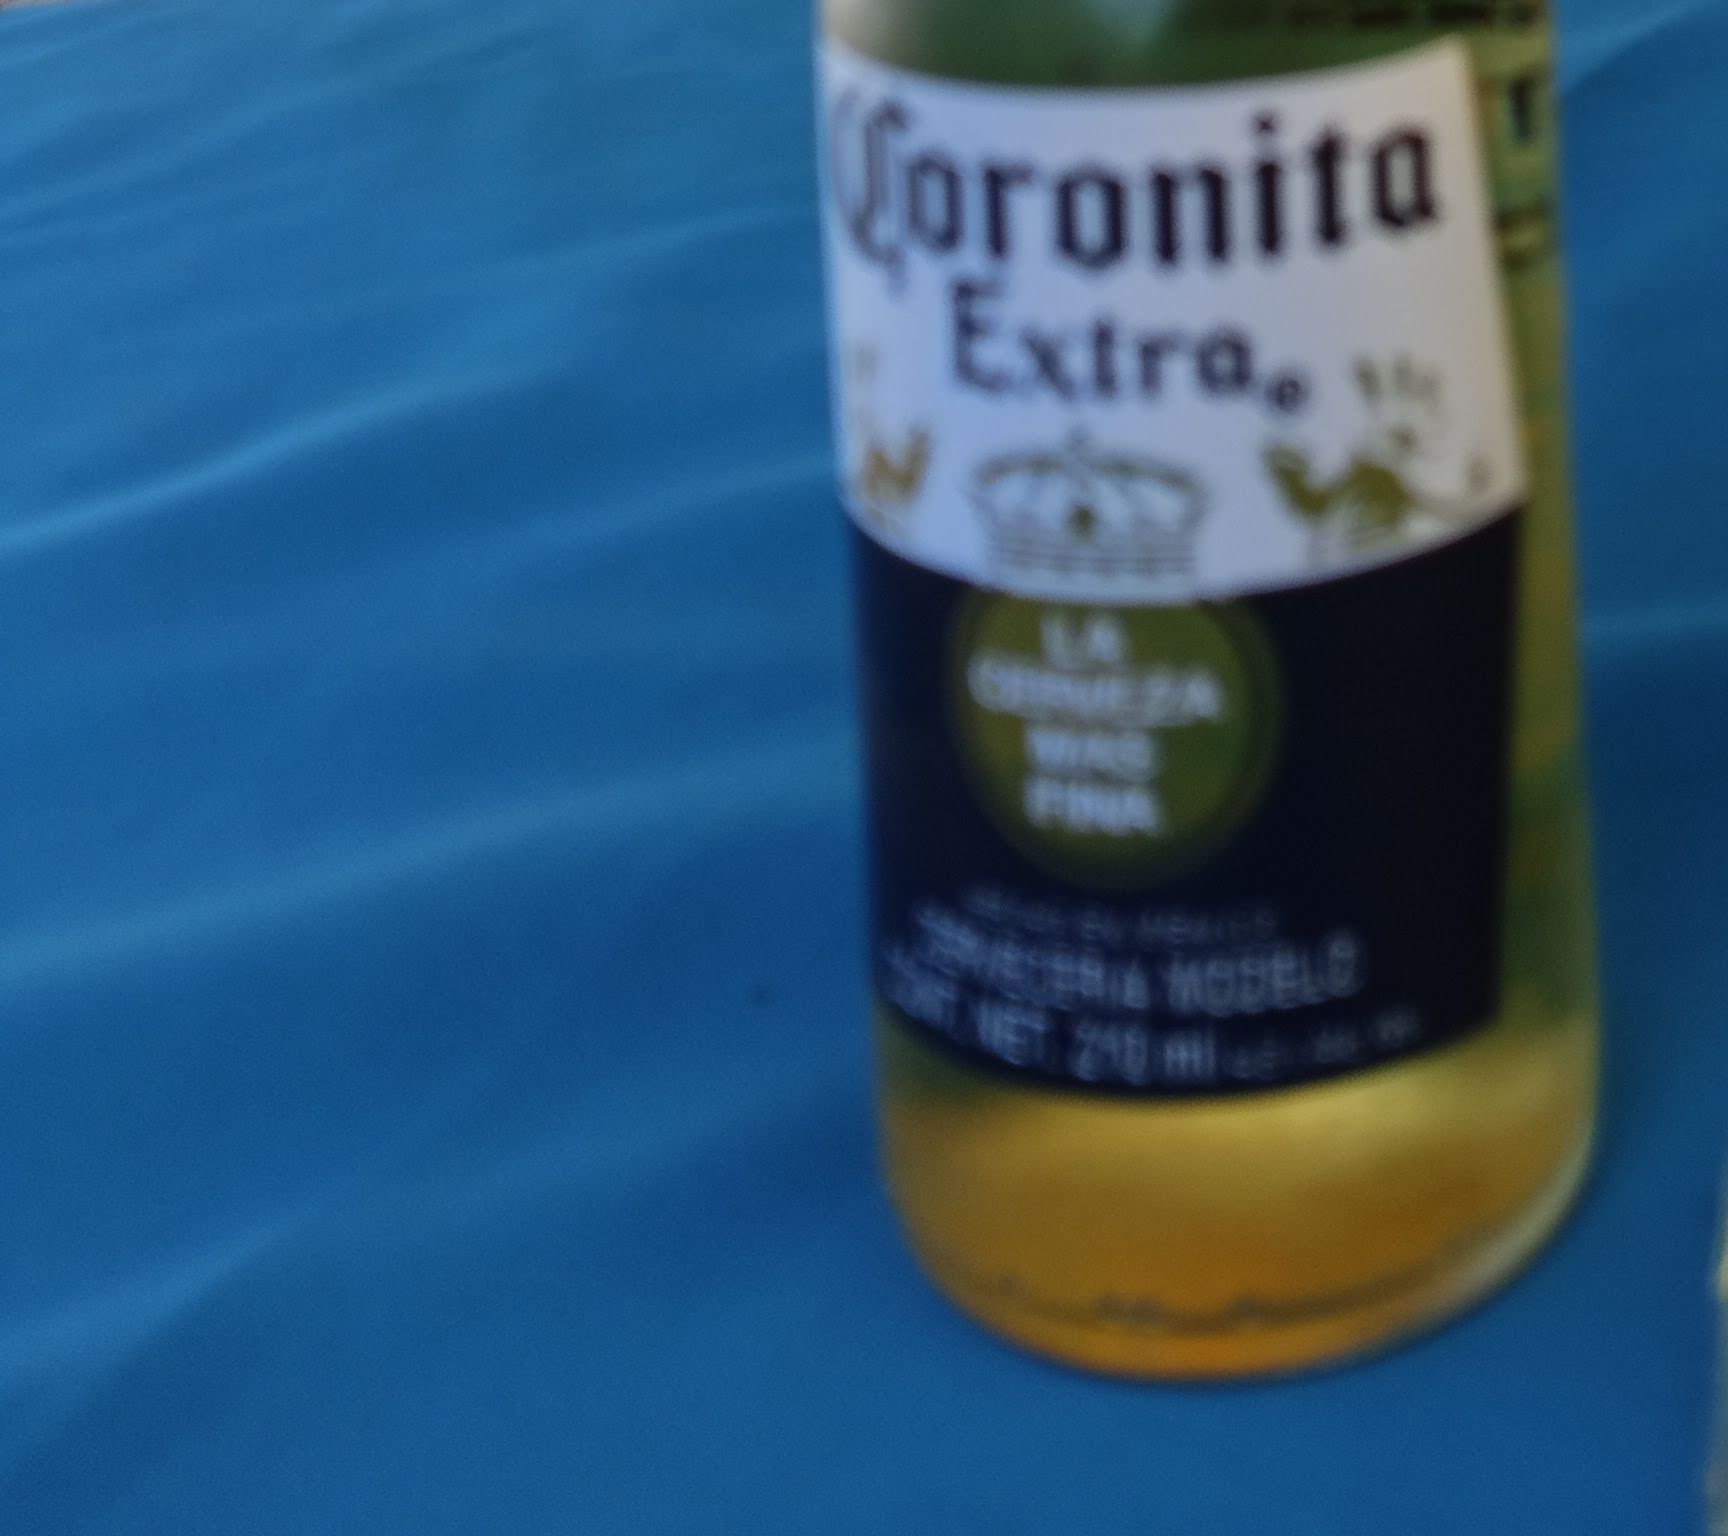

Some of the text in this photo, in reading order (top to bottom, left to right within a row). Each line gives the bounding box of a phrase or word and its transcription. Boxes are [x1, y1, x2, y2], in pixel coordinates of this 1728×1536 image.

[831, 83, 1440, 296] Coronita
[952, 276, 1256, 400] Extra
[1040, 613, 1128, 669] LA
[1024, 777, 1162, 835] FINA
